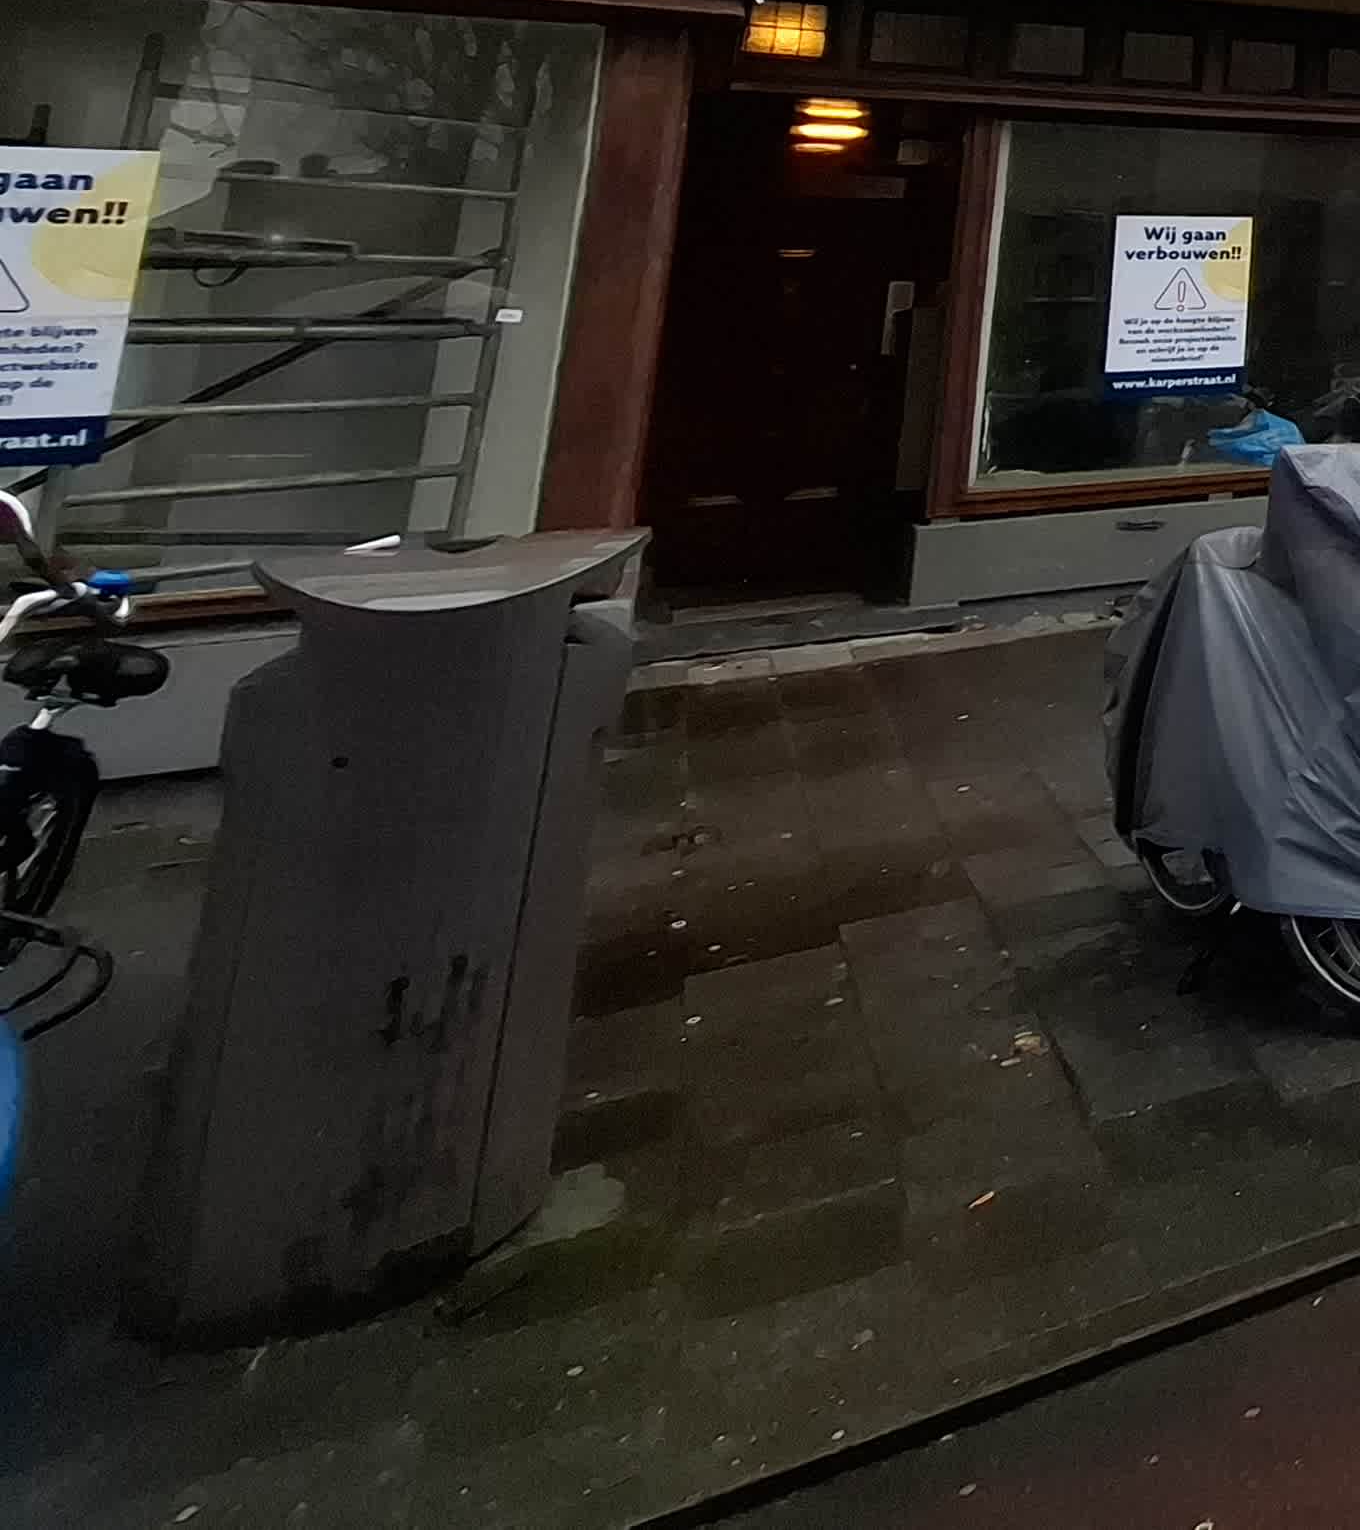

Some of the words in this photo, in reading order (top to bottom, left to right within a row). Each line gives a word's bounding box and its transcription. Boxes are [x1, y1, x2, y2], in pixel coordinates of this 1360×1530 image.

[1144, 227, 1177, 245] Wij
[1181, 230, 1227, 244] gaan
[1125, 246, 1242, 260] verbouwen!!
[1112, 373, 1237, 390] www.karperstraat.nl
